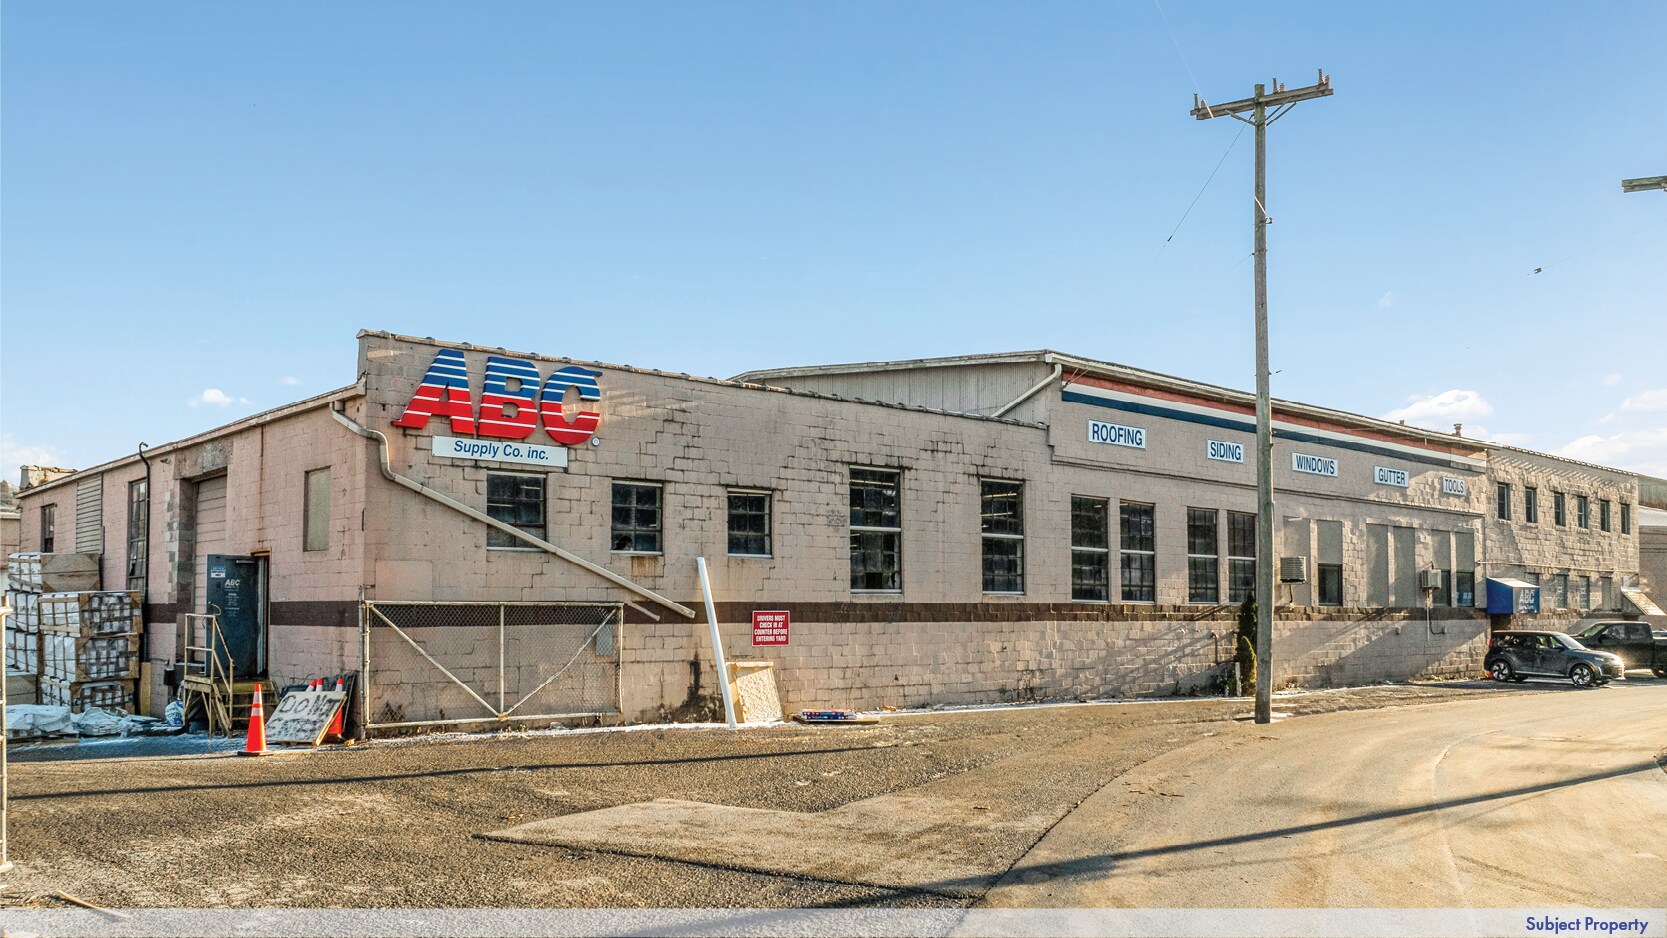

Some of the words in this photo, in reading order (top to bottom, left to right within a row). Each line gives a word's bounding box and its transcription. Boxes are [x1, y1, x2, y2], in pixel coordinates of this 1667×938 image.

[391, 348, 603, 445] ABC
[1092, 423, 1143, 446] ROOFING
[454, 440, 500, 459] Supply
[503, 444, 523, 458] Co.
[527, 446, 549, 460] inc.
[1210, 441, 1241, 460] SIDING
[1296, 455, 1335, 475] WINDOWS
[1378, 468, 1406, 486] GUTTER
[1445, 478, 1464, 494] TOOLS
[1519, 589, 1535, 603] ABC
